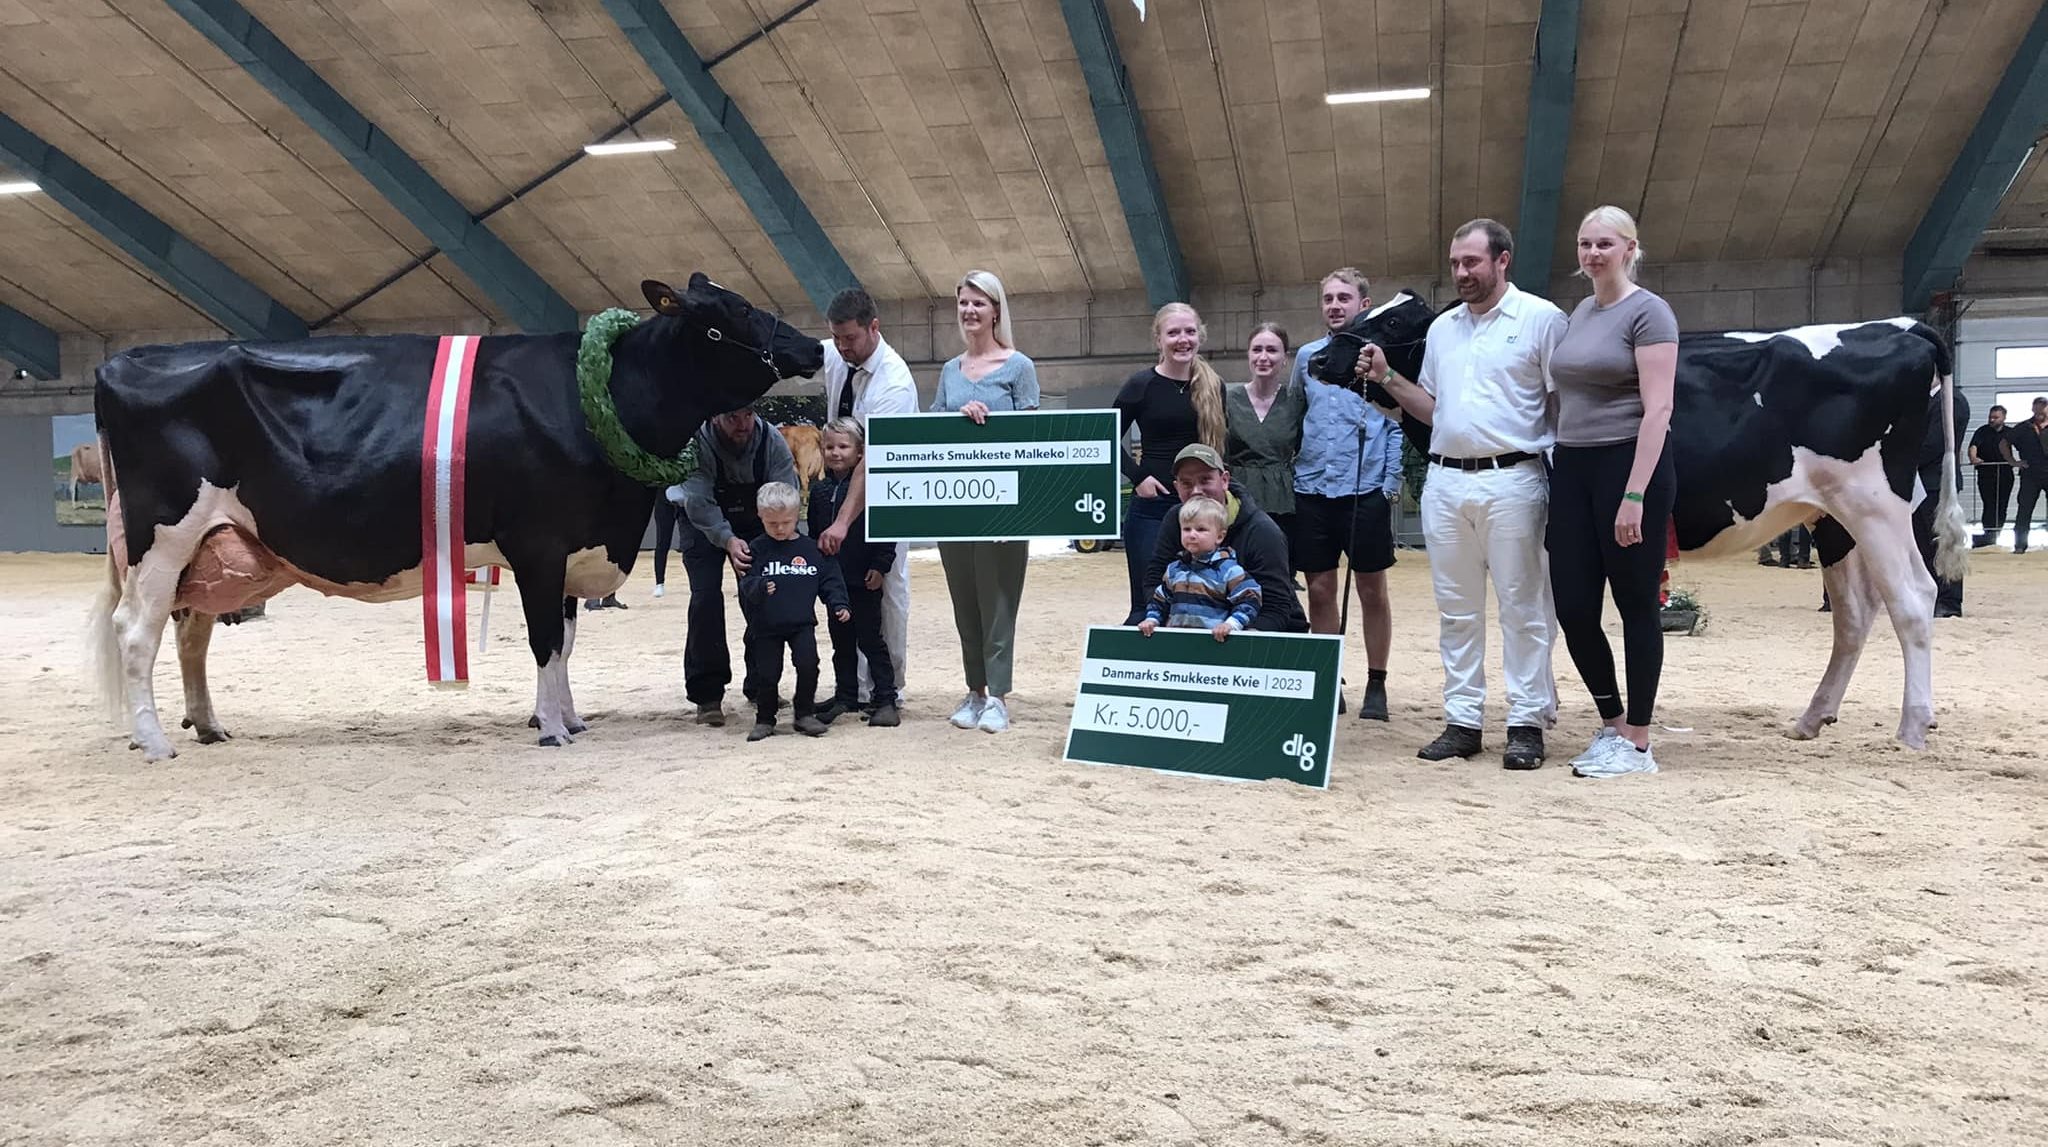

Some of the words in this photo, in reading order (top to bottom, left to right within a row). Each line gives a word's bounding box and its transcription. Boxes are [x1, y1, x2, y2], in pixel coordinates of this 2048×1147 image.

[886, 450, 944, 462] Danmarks
[947, 450, 1011, 461] Smukkeste
[1014, 448, 1065, 460] Malkeko
[1072, 447, 1100, 458] 2023
[887, 480, 912, 500] Kr.
[923, 479, 1007, 502] 10.000,-
[1075, 494, 1106, 524] dlg
[762, 561, 818, 576] ellesse
[1102, 666, 1160, 682] Danmarks
[1162, 671, 1229, 686] Smukkeste
[1232, 675, 1260, 688] Kvie
[1272, 677, 1302, 691] 2023
[1093, 702, 1118, 726] Kr.
[1126, 706, 1200, 737] 5.000,-
[1282, 733, 1317, 772] dlg
